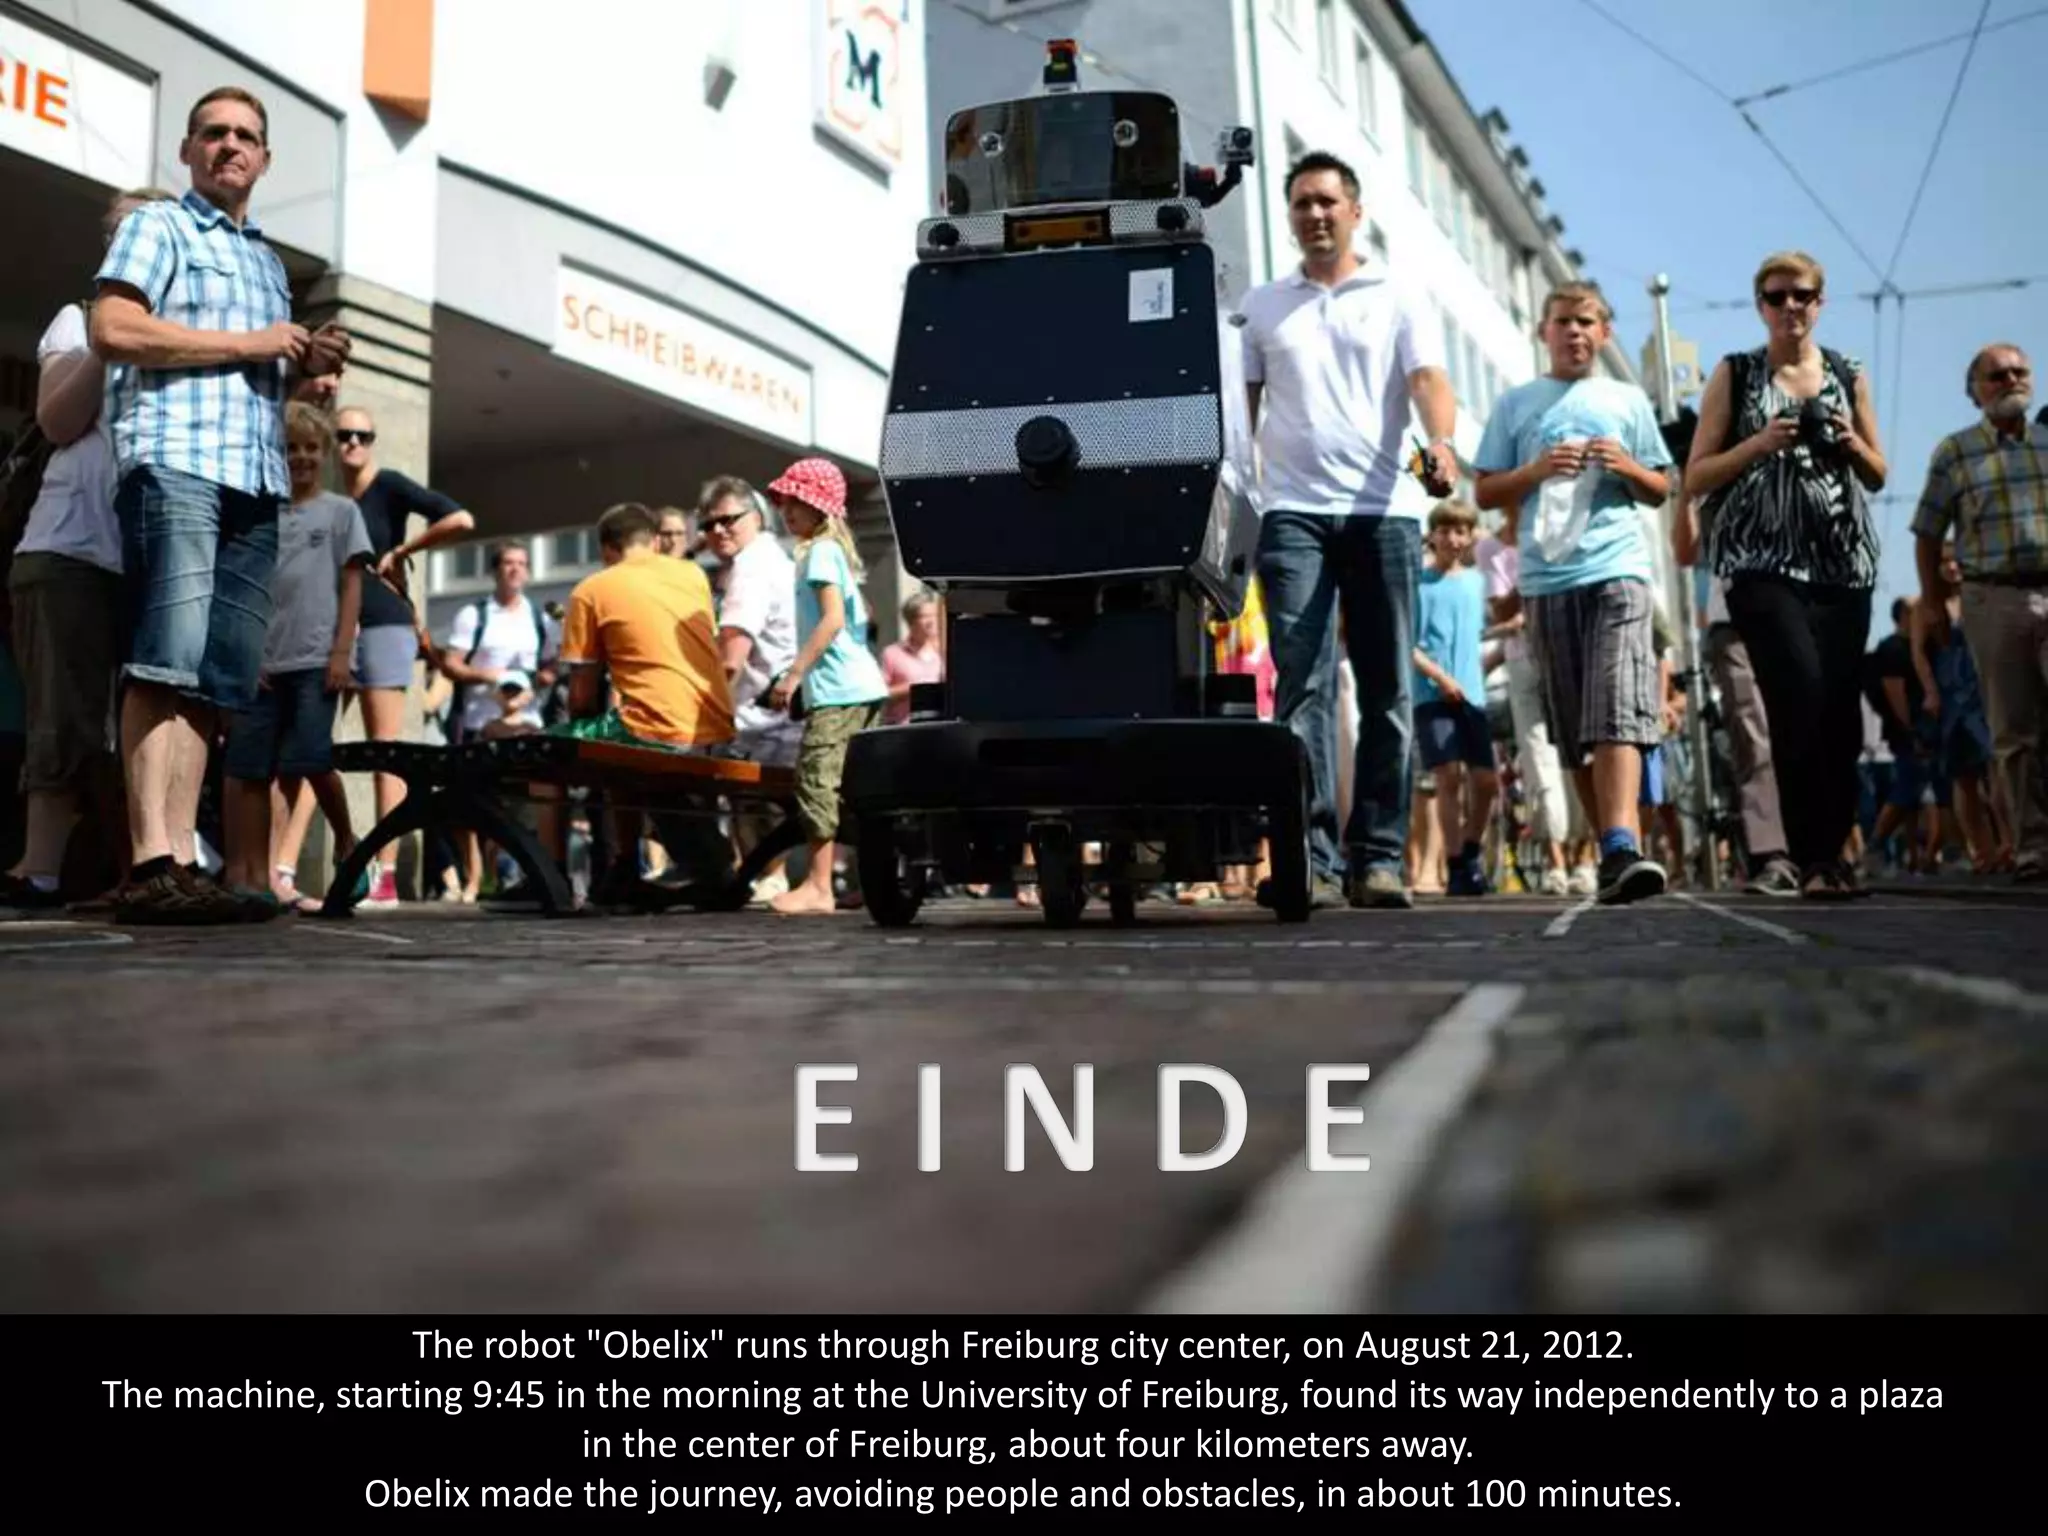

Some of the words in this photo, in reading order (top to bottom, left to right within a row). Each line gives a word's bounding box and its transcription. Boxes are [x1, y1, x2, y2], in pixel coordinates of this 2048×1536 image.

[0, 57, 68, 130] IE
[846, 29, 882, 110] M
[563, 294, 804, 414] SCHREIBWAREN
